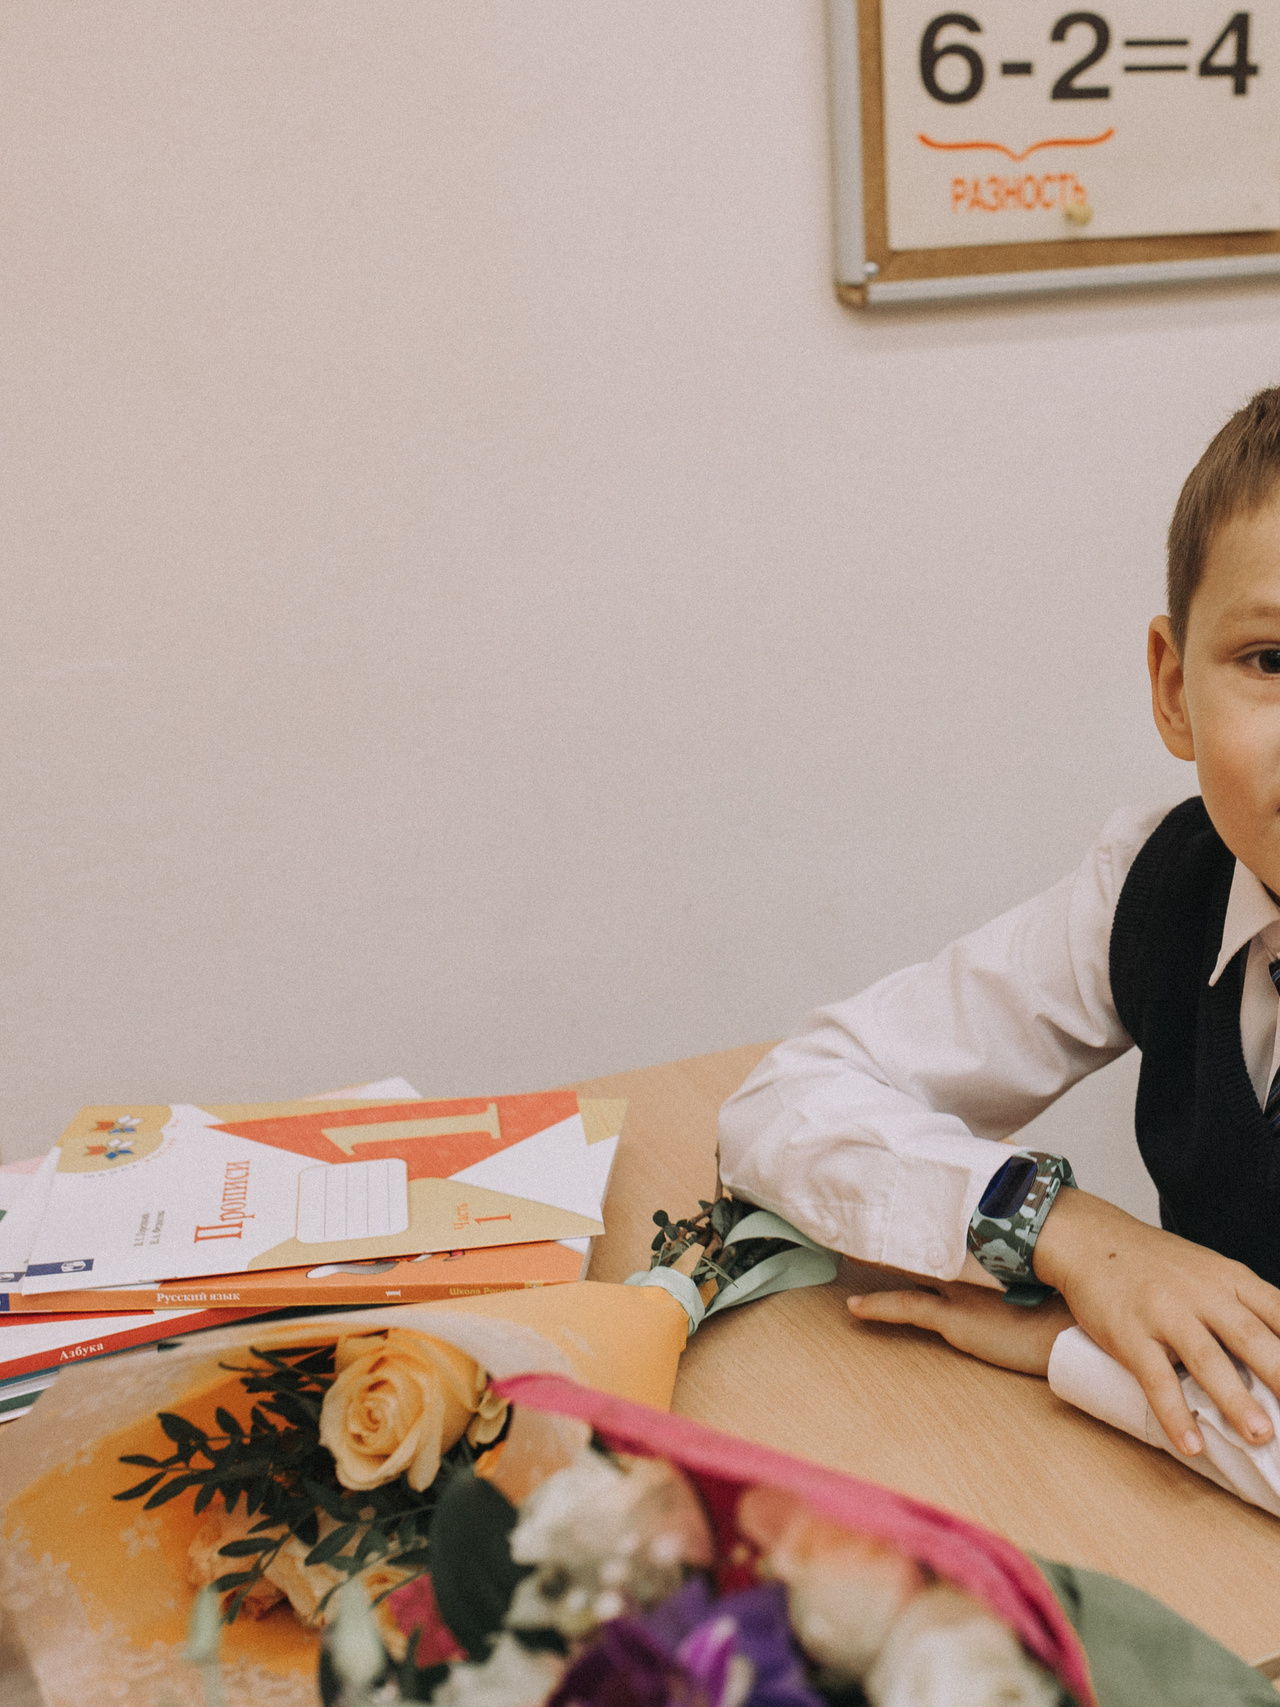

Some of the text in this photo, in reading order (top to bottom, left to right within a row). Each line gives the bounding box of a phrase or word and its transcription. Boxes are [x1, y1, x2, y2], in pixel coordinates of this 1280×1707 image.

[320, 1102, 502, 1157] 1
[193, 1159, 255, 1244] Прописи
[473, 1211, 513, 1226] 1
[156, 1292, 207, 1305] Русский
[209, 1292, 241, 1301] язык
[59, 1342, 105, 1361] Азбука
